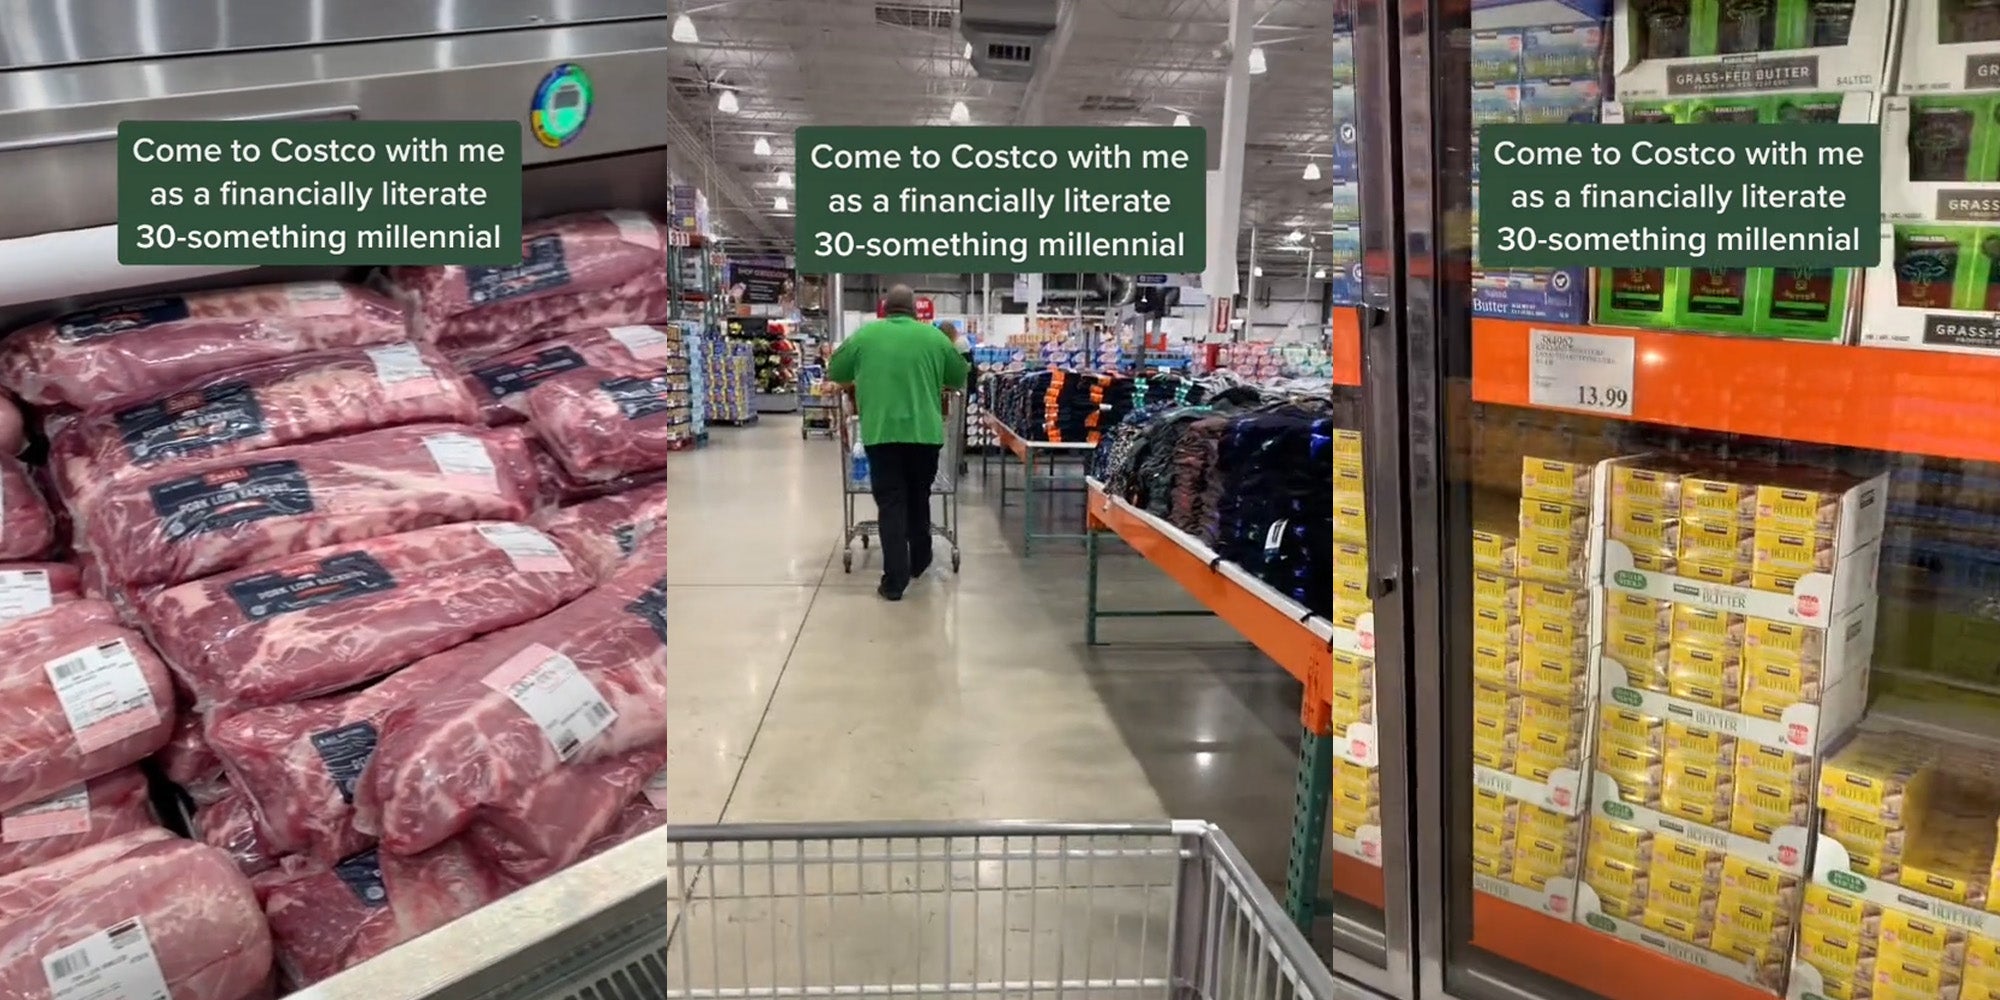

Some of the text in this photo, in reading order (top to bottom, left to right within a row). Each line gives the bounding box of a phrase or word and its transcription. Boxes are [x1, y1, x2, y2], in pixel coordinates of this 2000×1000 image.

[1676, 65, 1810, 86] GRASS-FED BUTTER
[1472, 298, 1507, 313] Butter
[1579, 386, 1628, 408] 13.99
[1702, 587, 1746, 609] BUTTER
